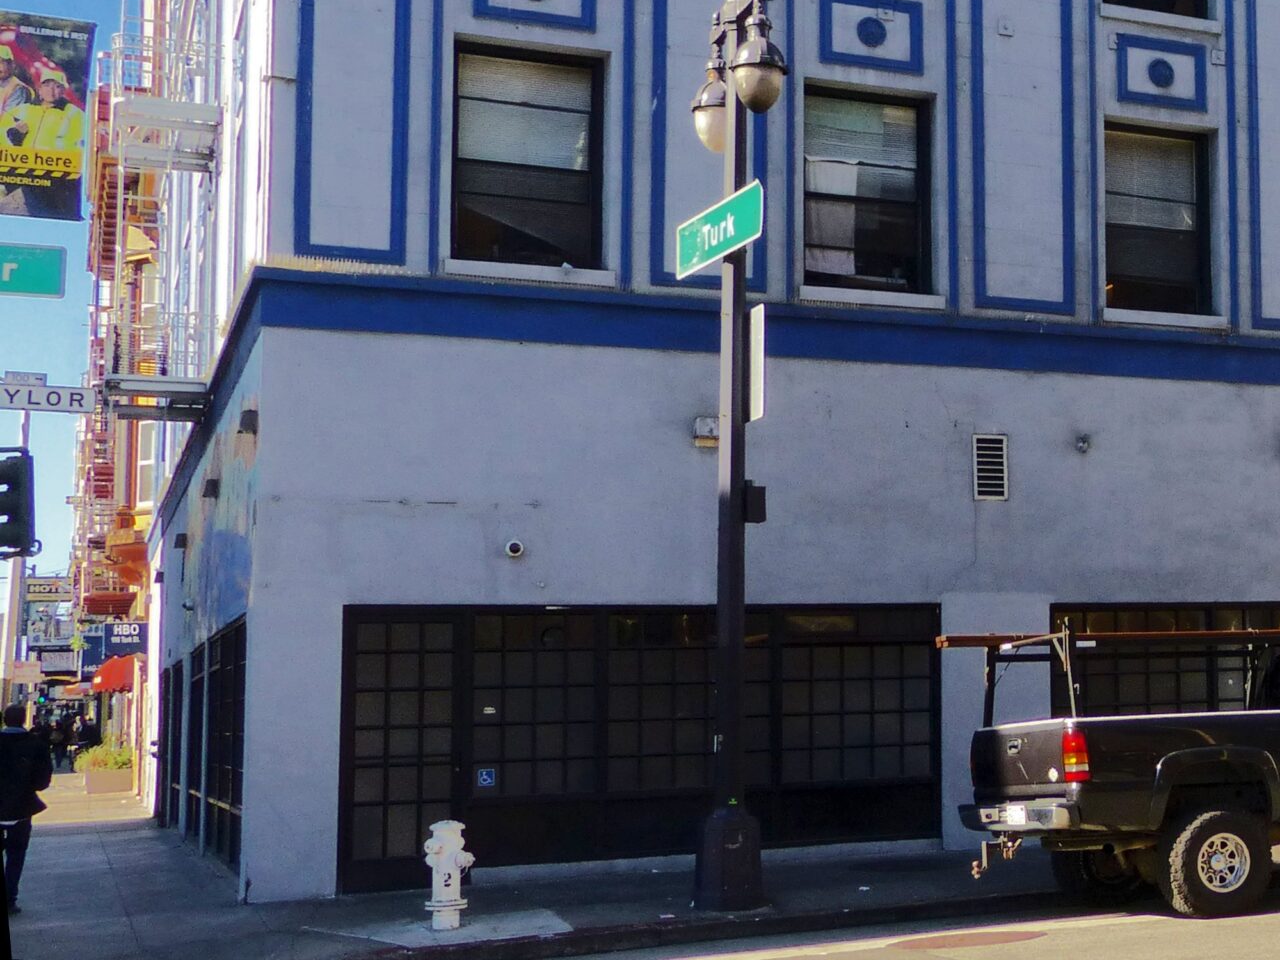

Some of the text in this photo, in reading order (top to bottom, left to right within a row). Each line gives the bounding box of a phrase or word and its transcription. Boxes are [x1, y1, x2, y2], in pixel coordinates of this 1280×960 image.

[702, 212, 735, 251] Turk
[113, 624, 139, 635] HBO
[443, 872, 452, 888] 2
